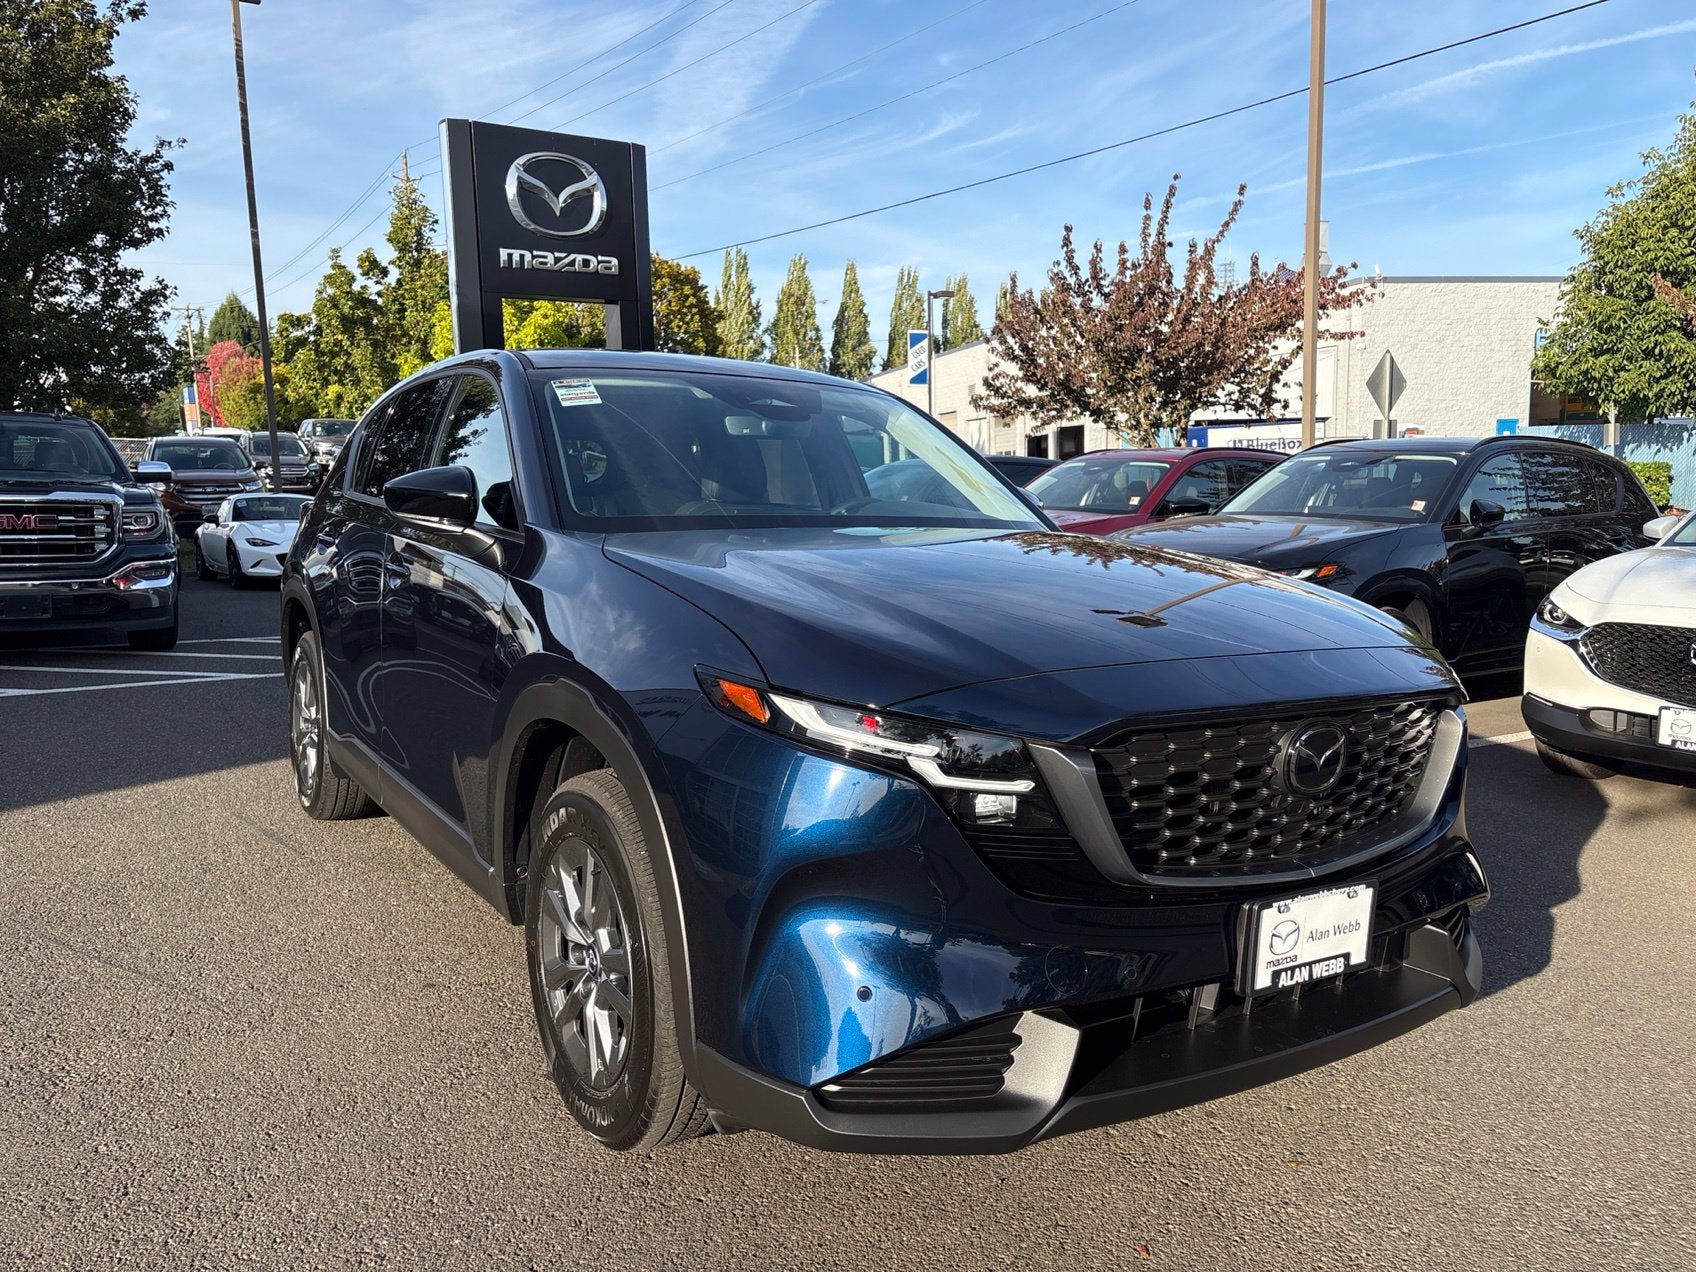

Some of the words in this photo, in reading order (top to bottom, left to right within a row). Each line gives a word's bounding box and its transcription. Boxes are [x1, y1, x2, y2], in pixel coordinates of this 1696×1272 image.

[499, 247, 619, 275] mazda
[911, 345, 926, 359] USED
[911, 359, 926, 372] CARS
[0, 514, 57, 529] MC
[1306, 927, 1330, 943] Alan
[1333, 919, 1361, 936] Webb
[1266, 954, 1298, 970] mazda
[1278, 965, 1310, 988] ALAN
[1311, 957, 1345, 979] WEBB
